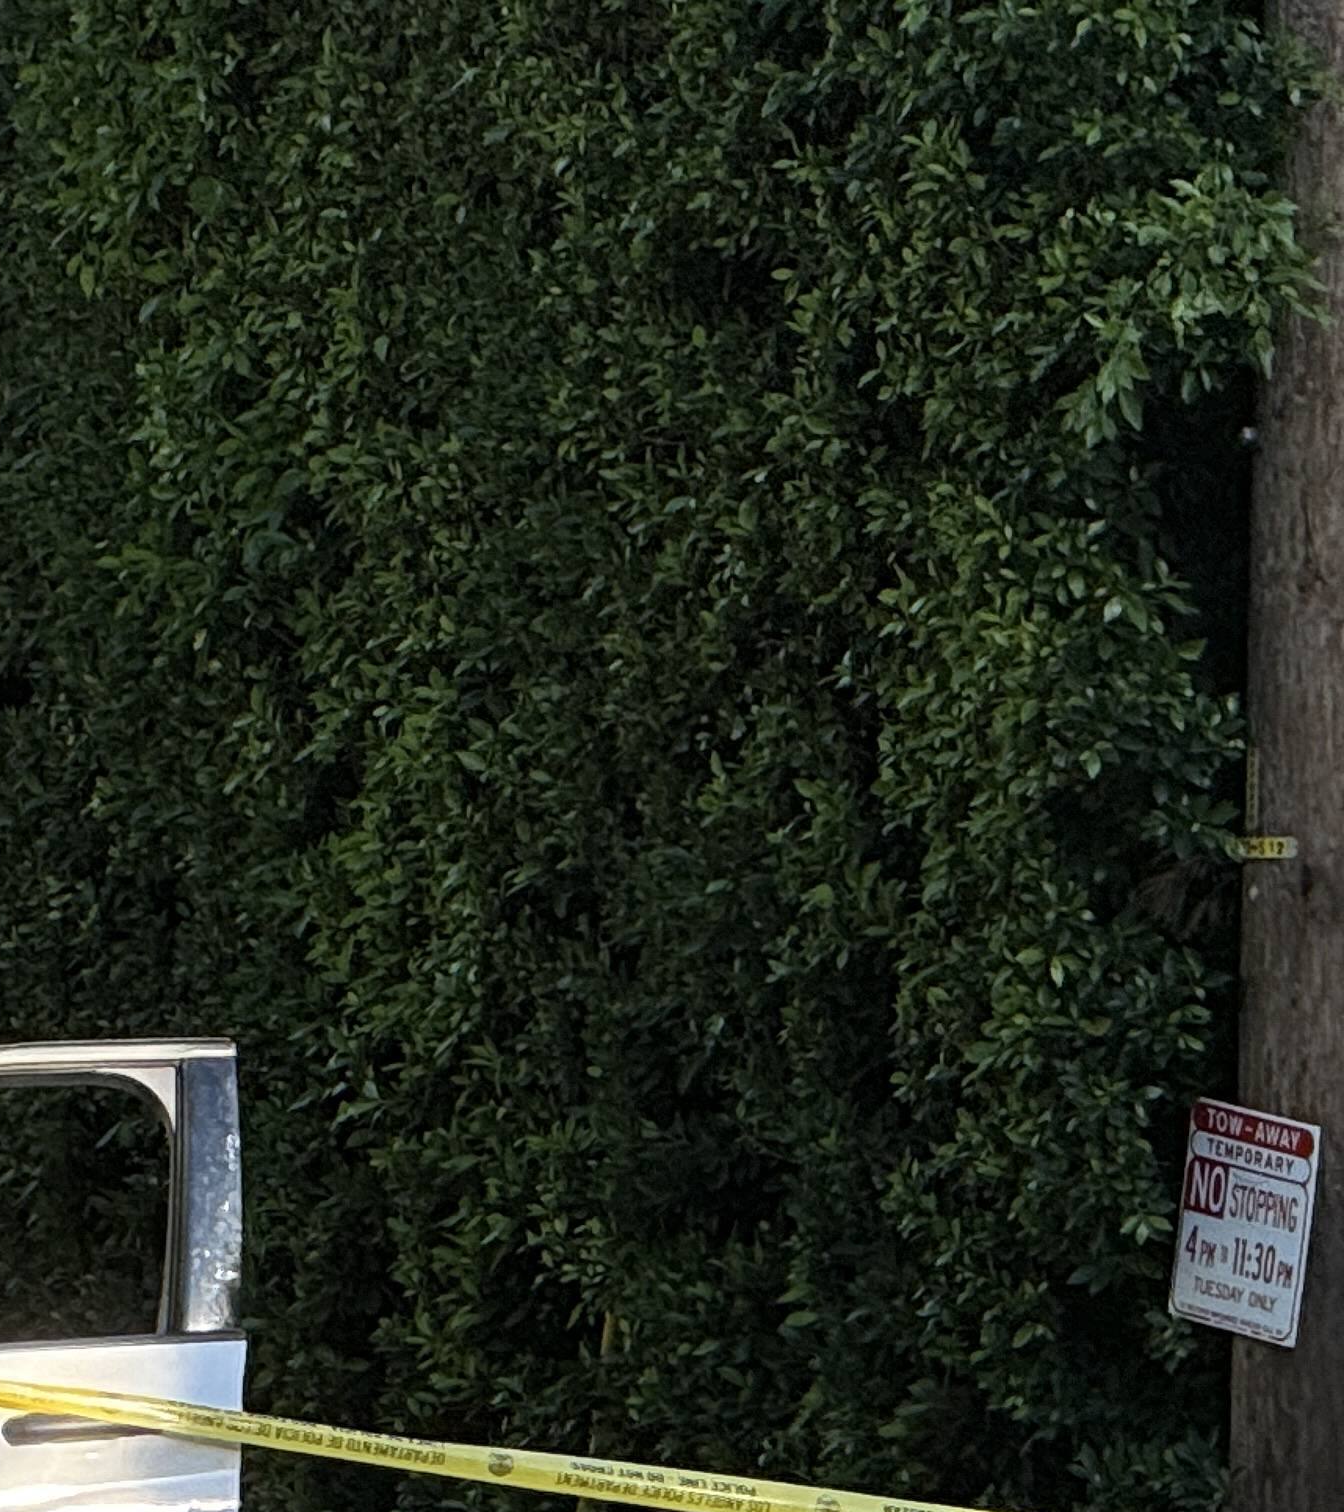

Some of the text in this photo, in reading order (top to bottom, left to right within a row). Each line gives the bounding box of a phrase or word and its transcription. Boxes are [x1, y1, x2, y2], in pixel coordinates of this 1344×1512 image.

[1207, 1107, 1300, 1151] TOW-AWAY
[1208, 1138, 1295, 1175] TEMPORARY
[1190, 1160, 1298, 1233] NO STOPPING
[1186, 1225, 1199, 1262] 4
[1233, 1237, 1276, 1283] 11:30
[1194, 1275, 1279, 1313] TUESDAY ONLY
